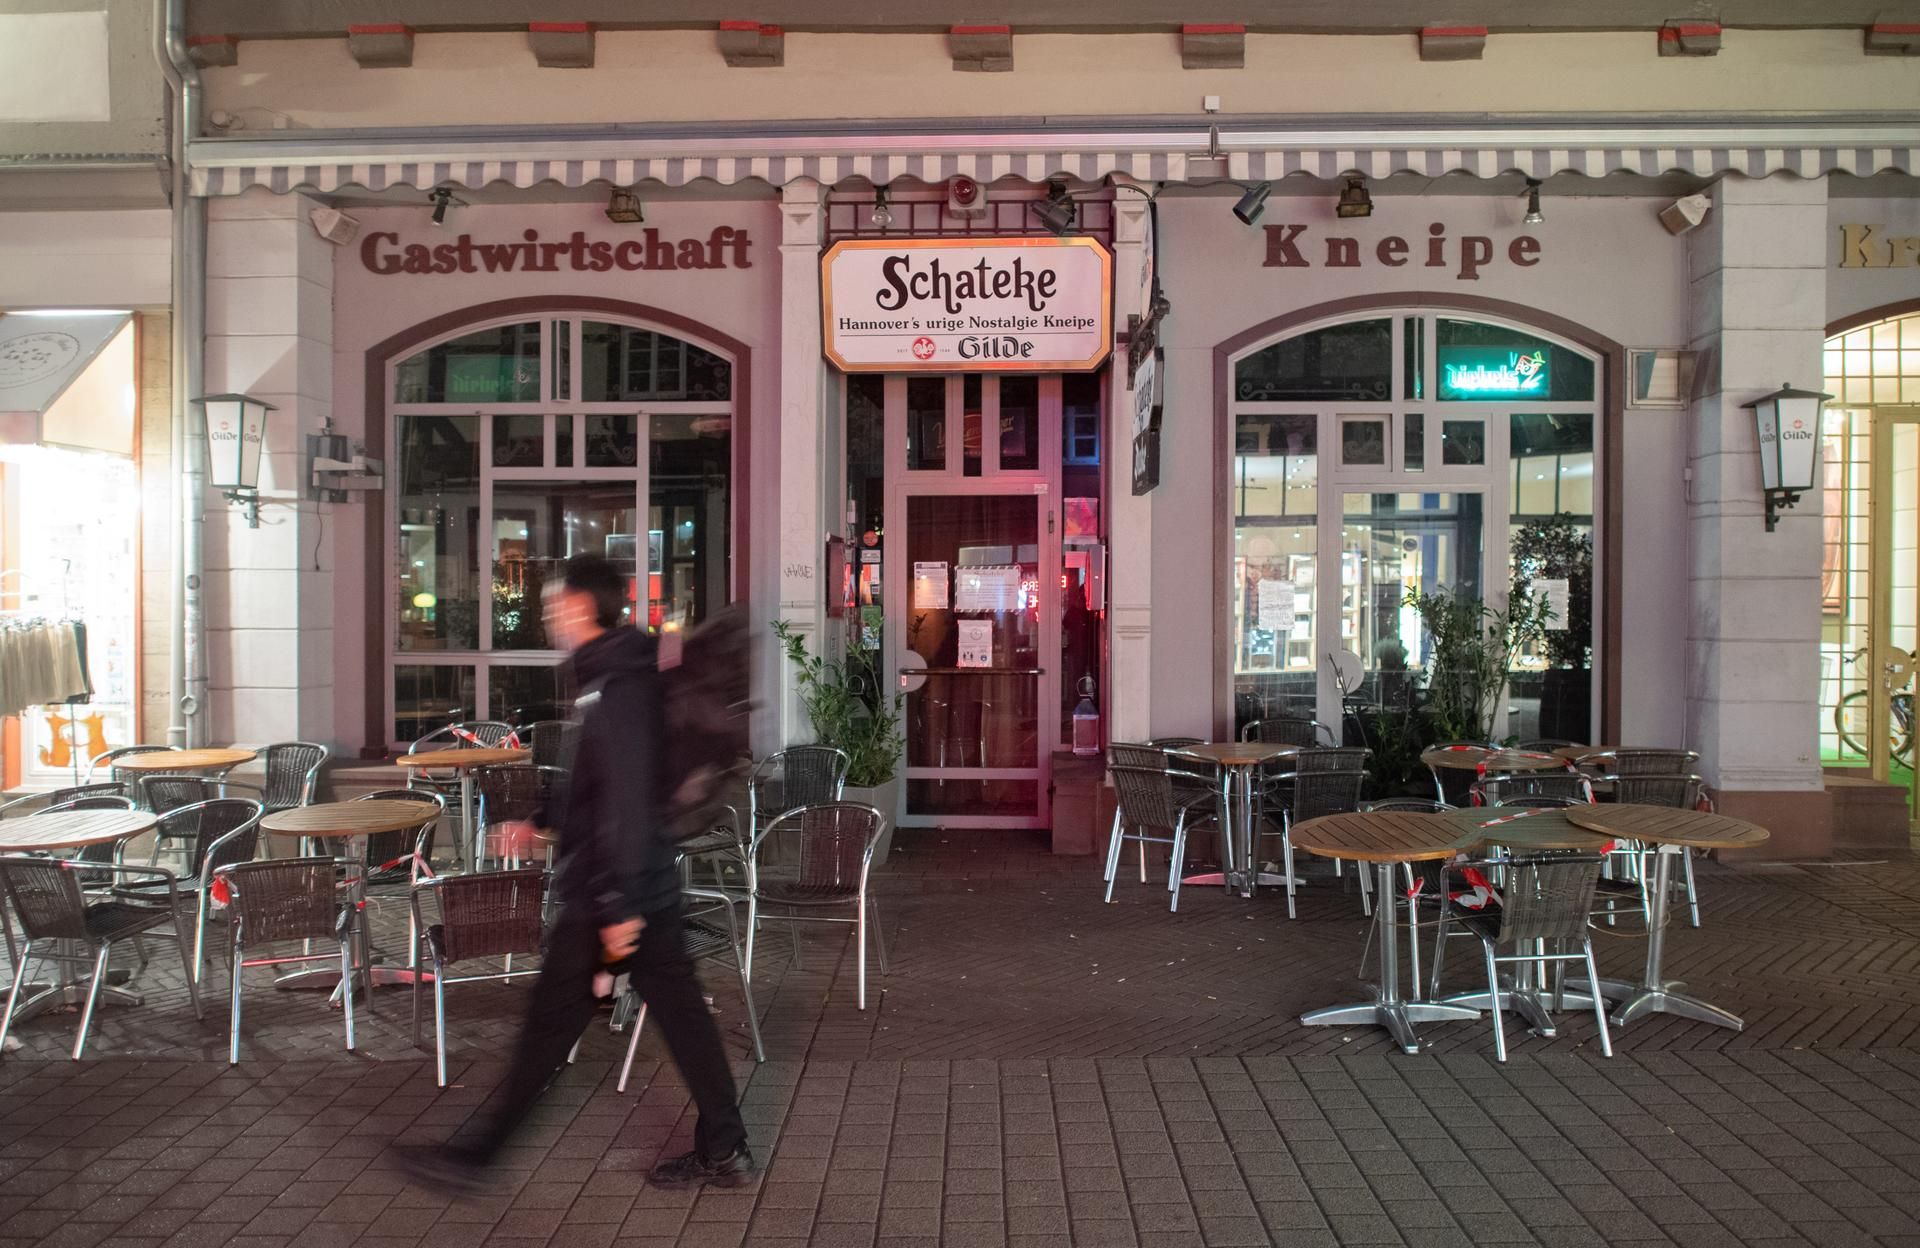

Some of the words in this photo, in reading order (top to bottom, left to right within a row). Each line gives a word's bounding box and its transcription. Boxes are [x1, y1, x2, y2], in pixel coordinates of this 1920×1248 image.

[360, 225, 753, 275] Gastwirtschaft
[1262, 222, 1541, 280] Kneipe
[1839, 223, 1920, 269] Kr
[876, 254, 1057, 314] Schateke
[839, 316, 920, 330] Hannover's
[926, 317, 964, 331] urige
[968, 315, 1038, 331] Nostalgie
[1043, 315, 1095, 331] Kneipe
[957, 336, 1035, 359] Gilde
[1782, 430, 1813, 440] Gilde
